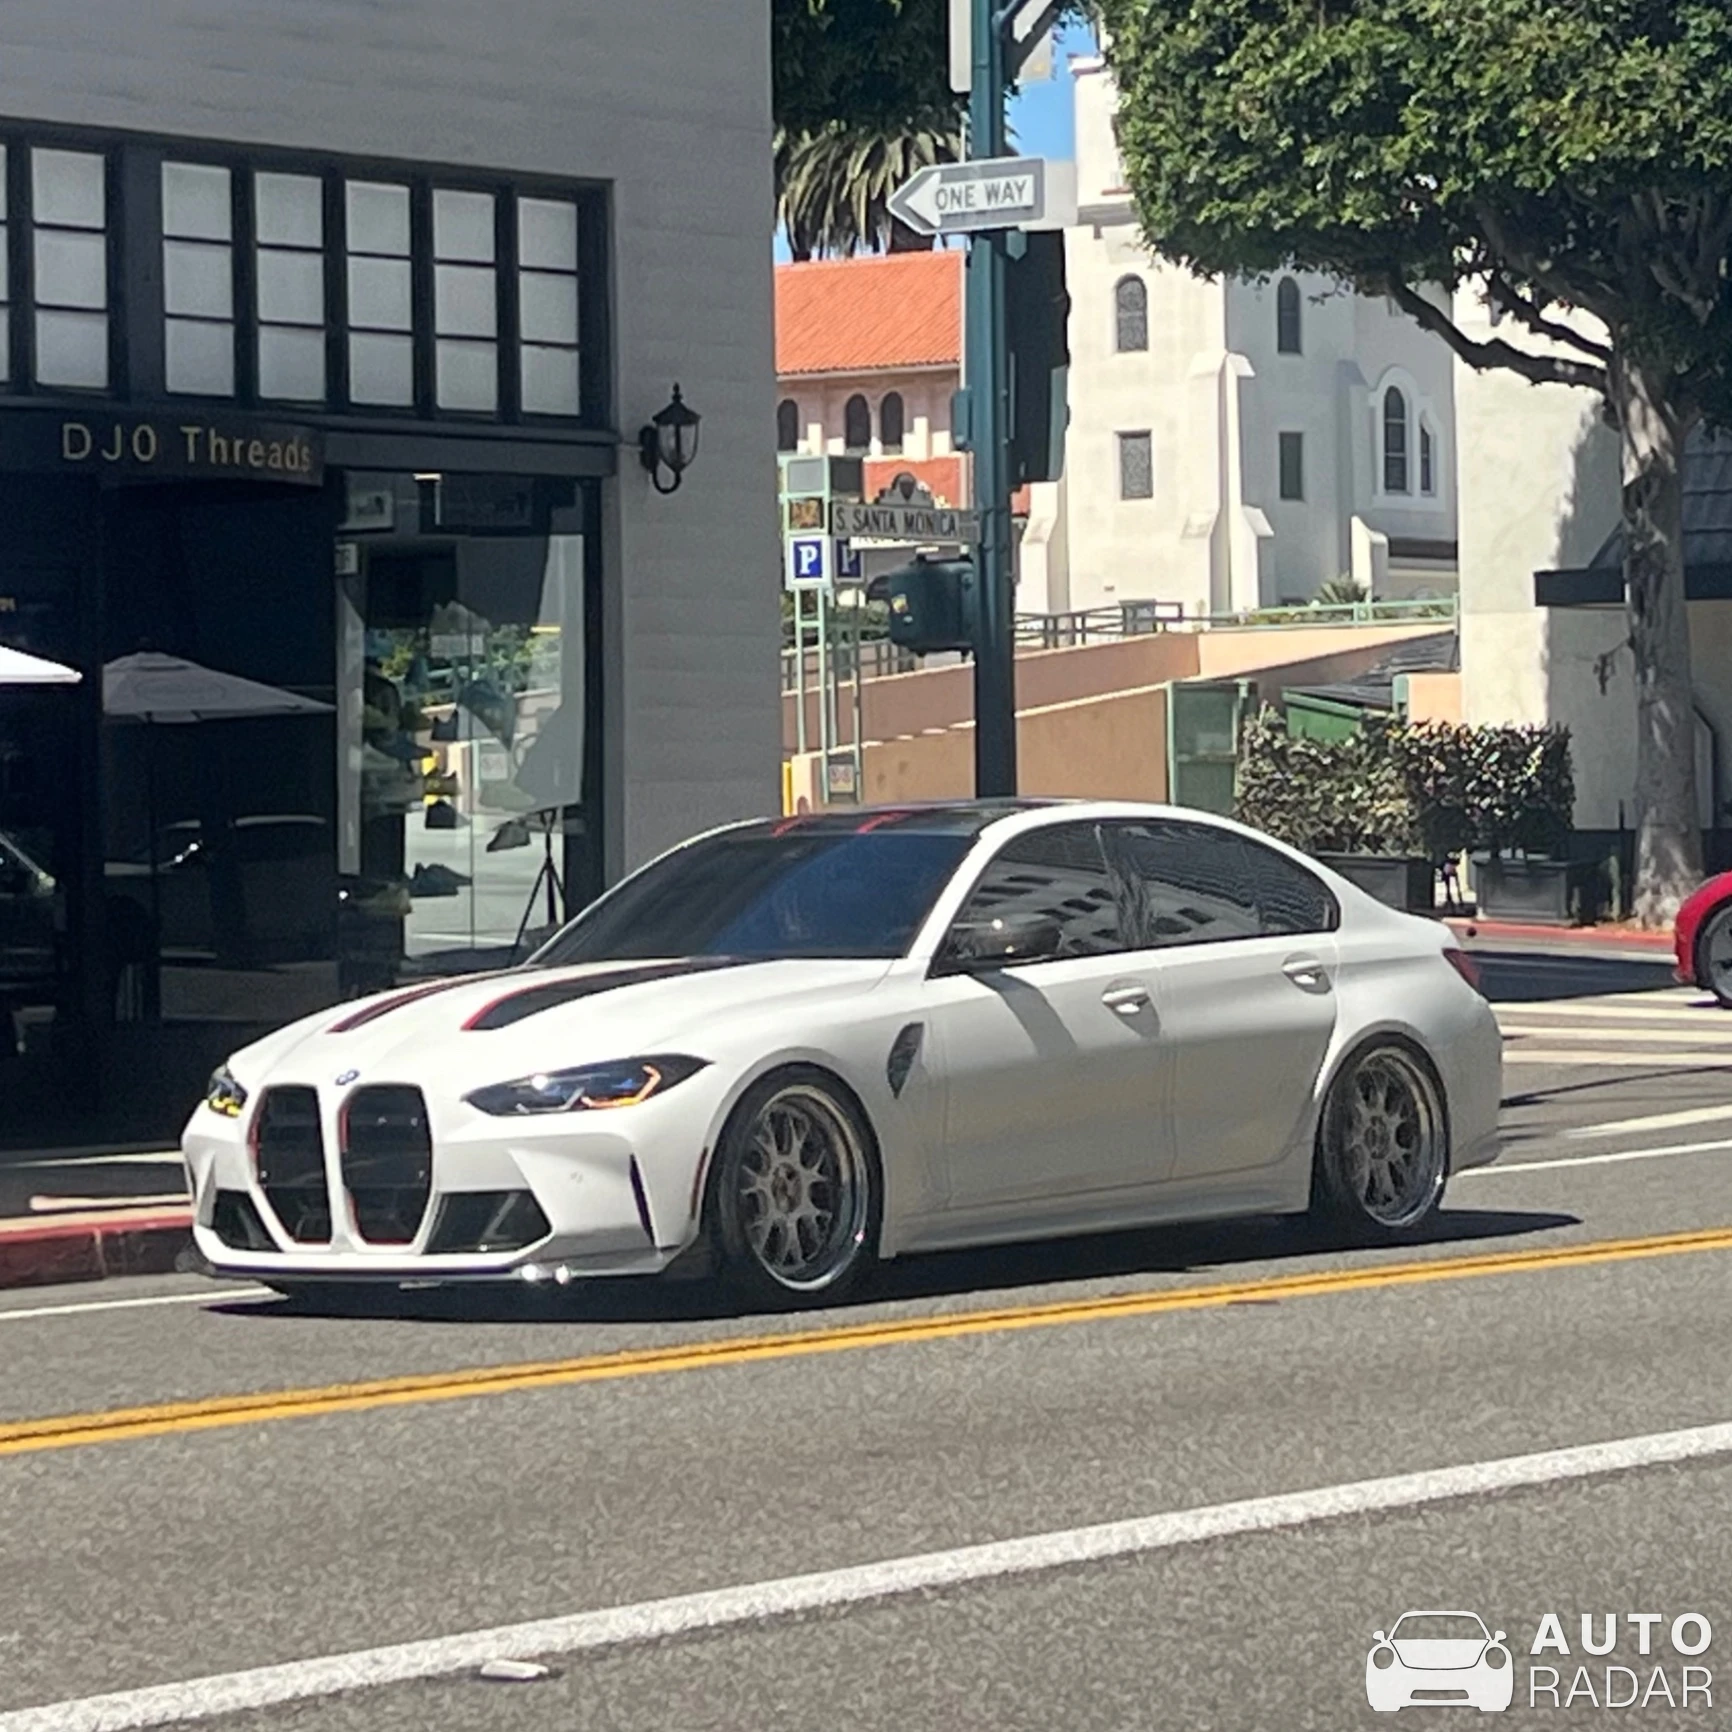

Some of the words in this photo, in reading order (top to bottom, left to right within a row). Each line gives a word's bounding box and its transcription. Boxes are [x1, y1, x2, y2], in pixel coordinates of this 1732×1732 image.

[935, 186, 976, 210] ONE
[984, 179, 1028, 205] WAY
[62, 422, 157, 462] DJO
[180, 425, 312, 472] Threads
[853, 509, 898, 533] SANTA
[798, 545, 818, 574] P
